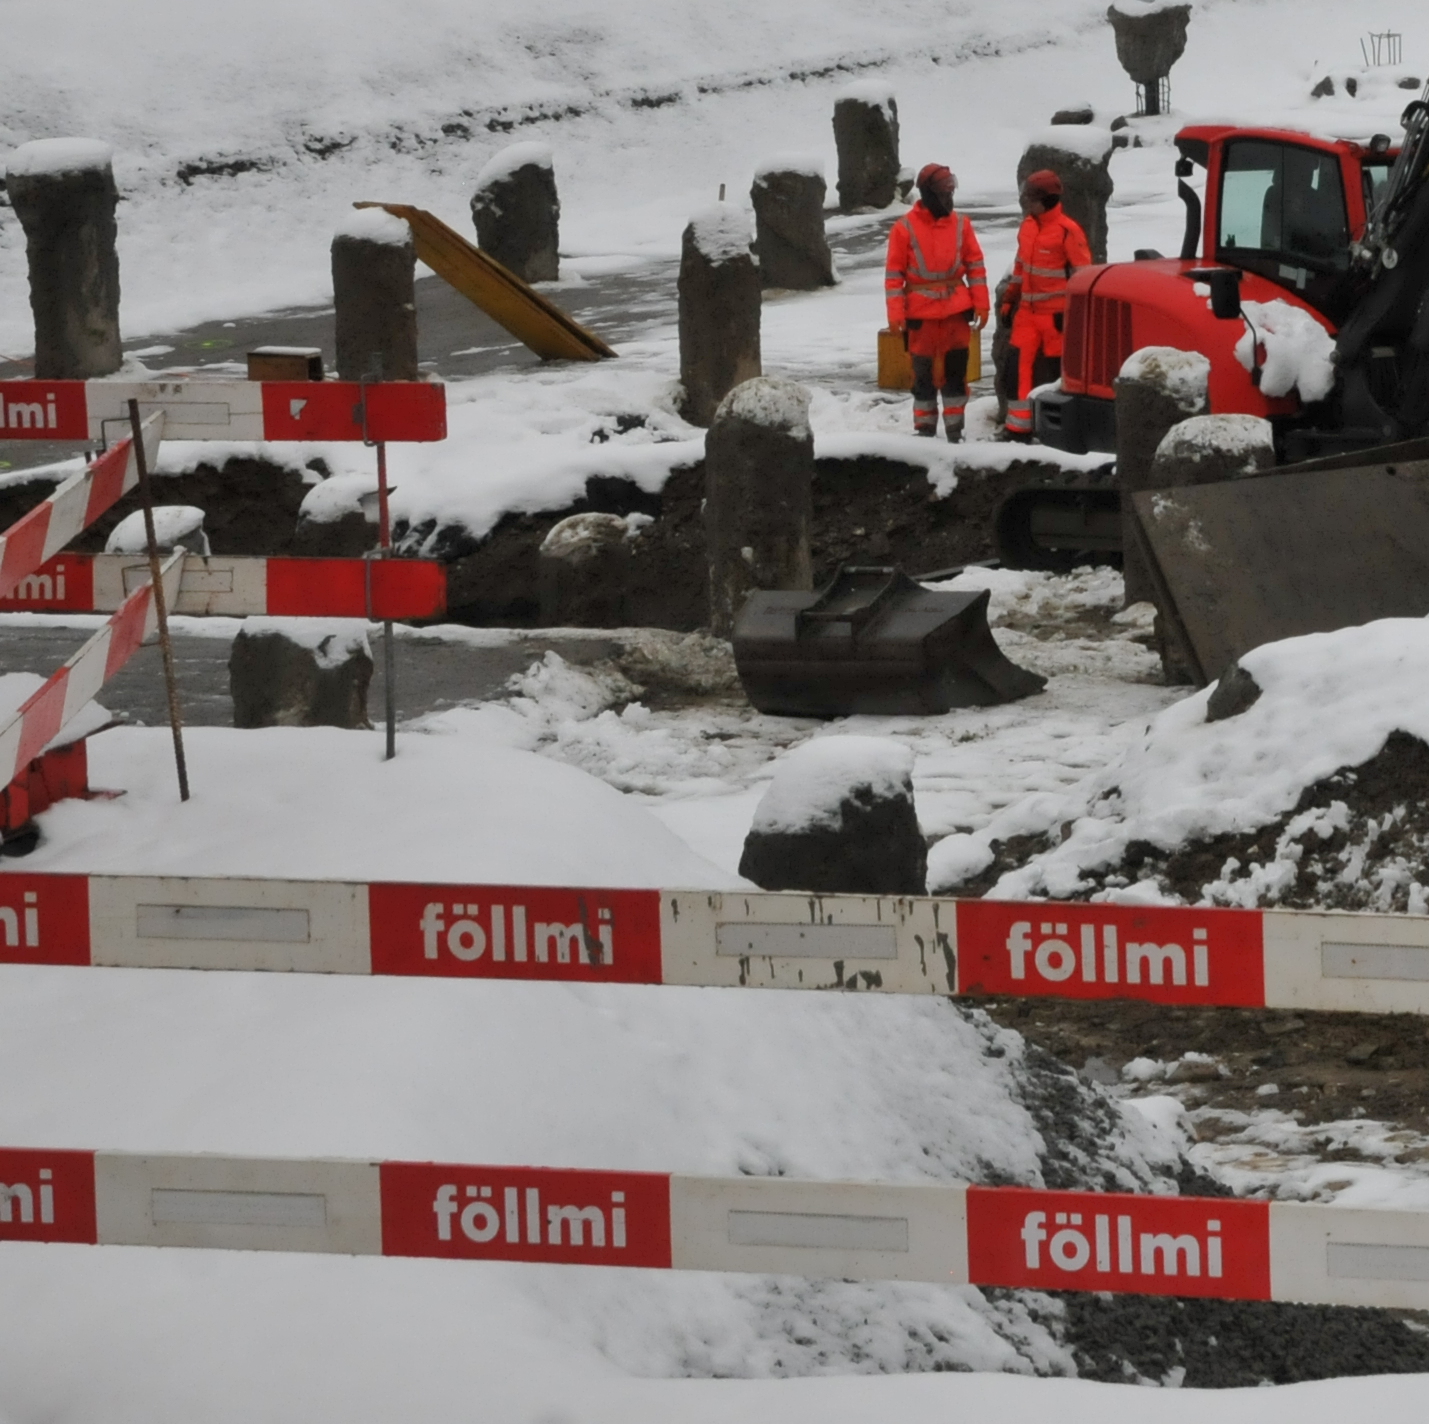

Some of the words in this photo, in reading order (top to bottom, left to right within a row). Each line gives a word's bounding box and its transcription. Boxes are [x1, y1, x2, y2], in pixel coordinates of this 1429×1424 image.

[421, 903, 613, 965] föllmi
[1007, 922, 1209, 986] föllmi
[433, 1184, 627, 1248] föllmi
[1020, 1211, 1223, 1278] föllmi
